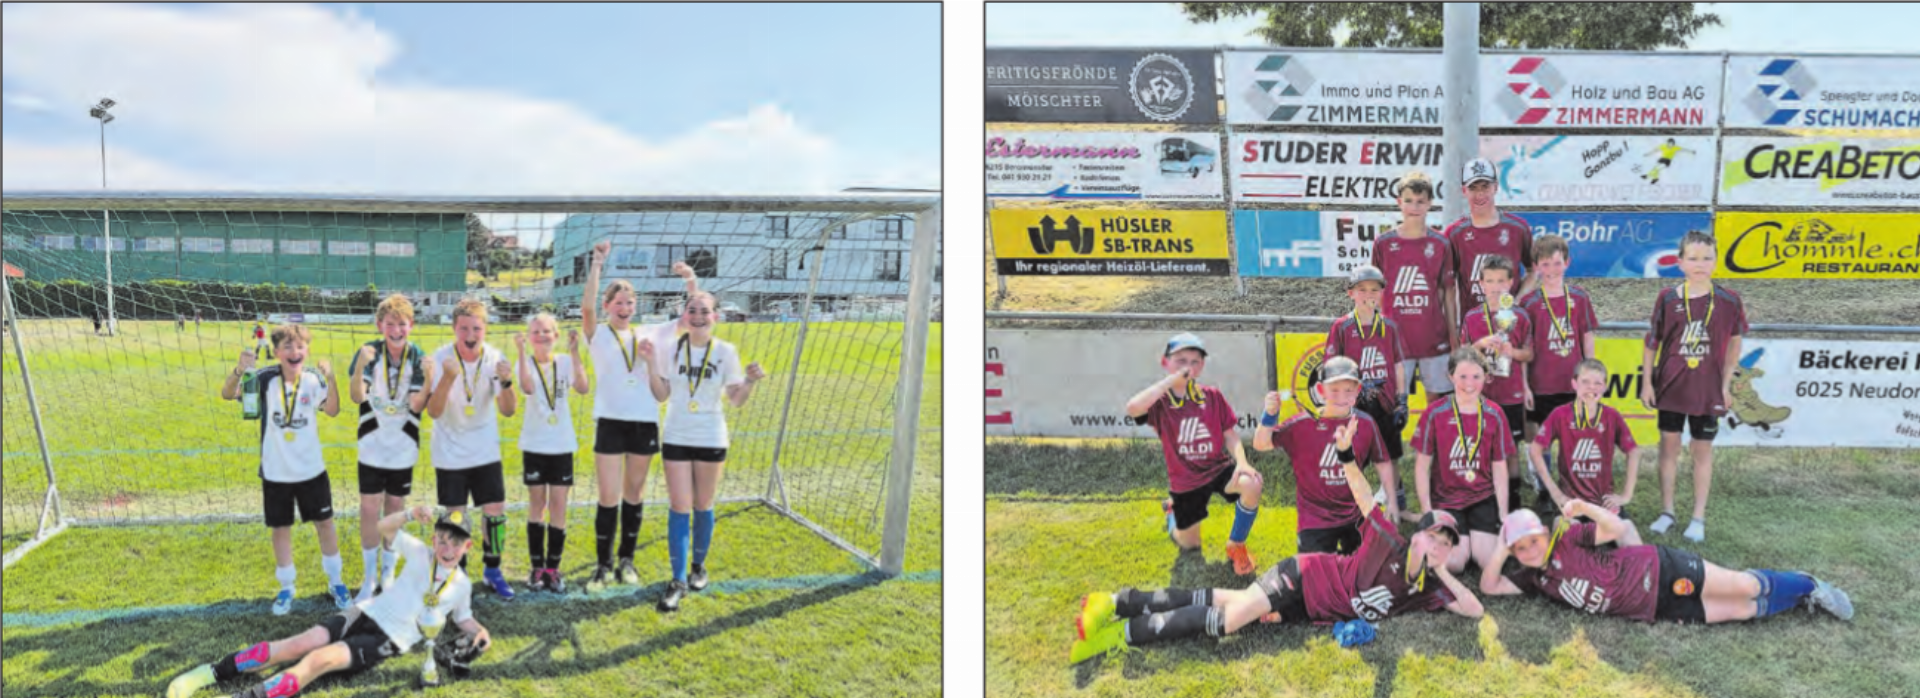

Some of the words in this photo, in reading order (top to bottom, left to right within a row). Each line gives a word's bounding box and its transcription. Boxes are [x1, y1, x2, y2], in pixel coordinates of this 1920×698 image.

[986, 66, 1117, 81] FRITIGSFRÖNDE
[1321, 85, 1360, 98] Immo
[1366, 85, 1392, 98] und
[1398, 85, 1430, 98] Plan
[1572, 85, 1607, 100] Holz
[1613, 86, 1641, 100] und
[1647, 86, 1677, 100] Bau
[1682, 86, 1705, 100] AG
[1820, 90, 1873, 103] Spengler
[1876, 91, 1899, 102] und
[1007, 93, 1103, 108] MÖISCHTER
[1555, 107, 1704, 126] ZIMMERMANN
[1243, 140, 1348, 164] STUDER
[1581, 139, 1611, 163] Hopp
[1101, 215, 1172, 234] HÜSLER
[1621, 219, 1653, 242] AG
[1103, 237, 1194, 254] SB-TRANS
[1015, 260, 1034, 272] Ihr
[1036, 260, 1103, 275] regionaler
[1106, 260, 1211, 274] Heizöl-Lieferant.
[1393, 295, 1429, 309] ALDI
[1678, 343, 1710, 356] ALDI
[1798, 350, 1909, 371] Bäckerei
[1362, 368, 1388, 380] ALDI
[1796, 381, 1843, 398] 6025
[1178, 442, 1214, 455] ALDI
[1319, 468, 1347, 480] ALD
[1571, 461, 1602, 473] ALDI
